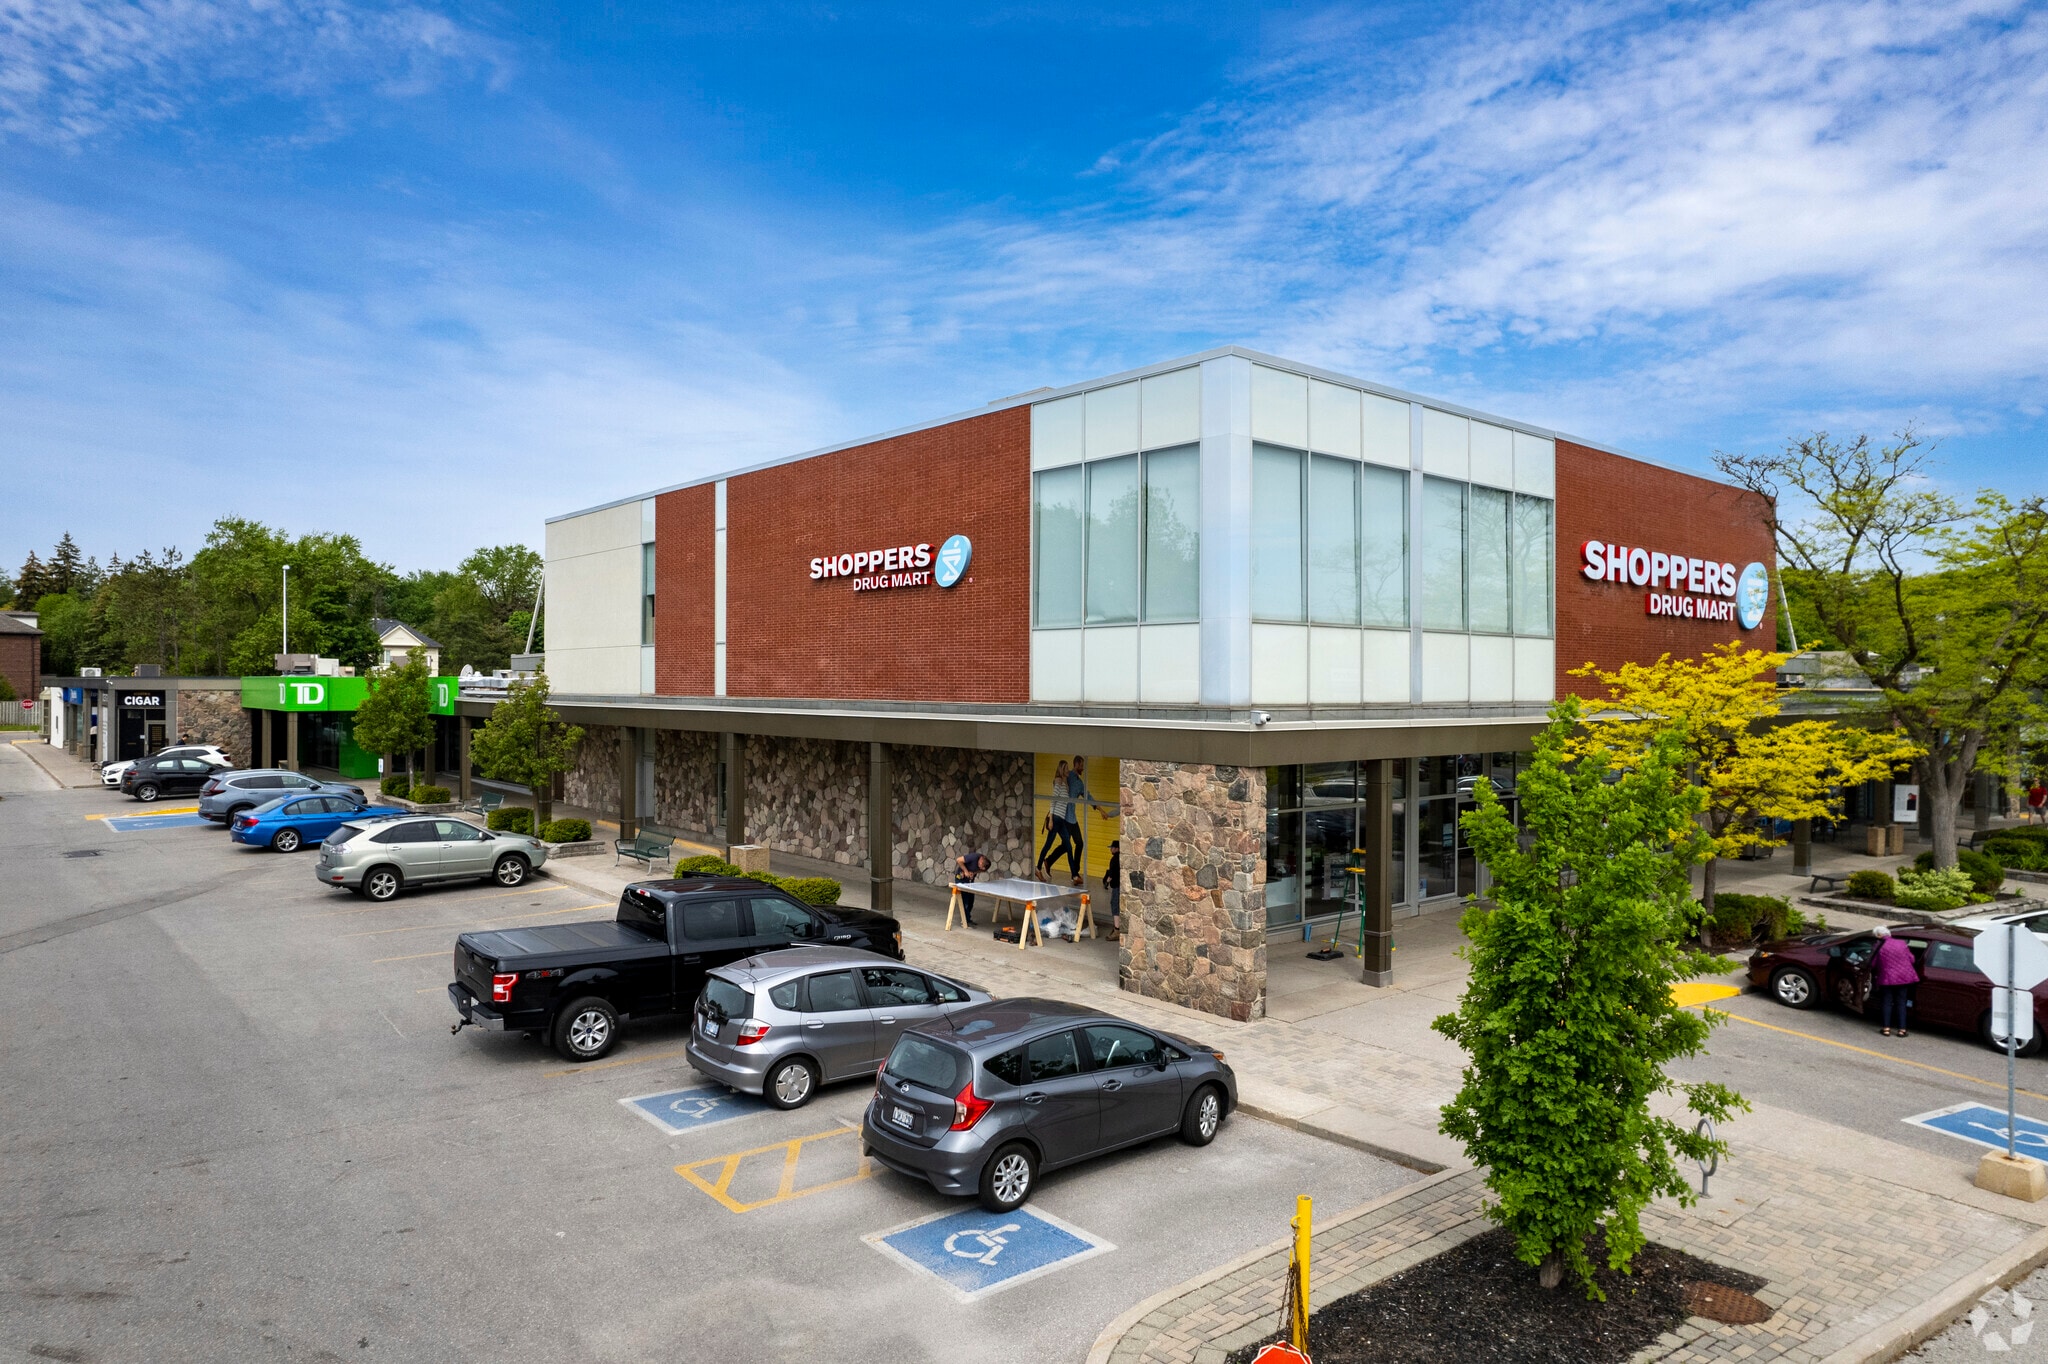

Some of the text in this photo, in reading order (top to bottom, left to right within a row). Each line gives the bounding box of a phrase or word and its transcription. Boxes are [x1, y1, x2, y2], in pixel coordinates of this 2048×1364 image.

[809, 543, 934, 580] SHOPPERS
[1581, 540, 1737, 597] SHOPPERS
[853, 571, 931, 591] DRUG MART
[1648, 593, 1736, 622] DRUG MART
[124, 696, 160, 706] CIGAR
[290, 683, 325, 704] TD
